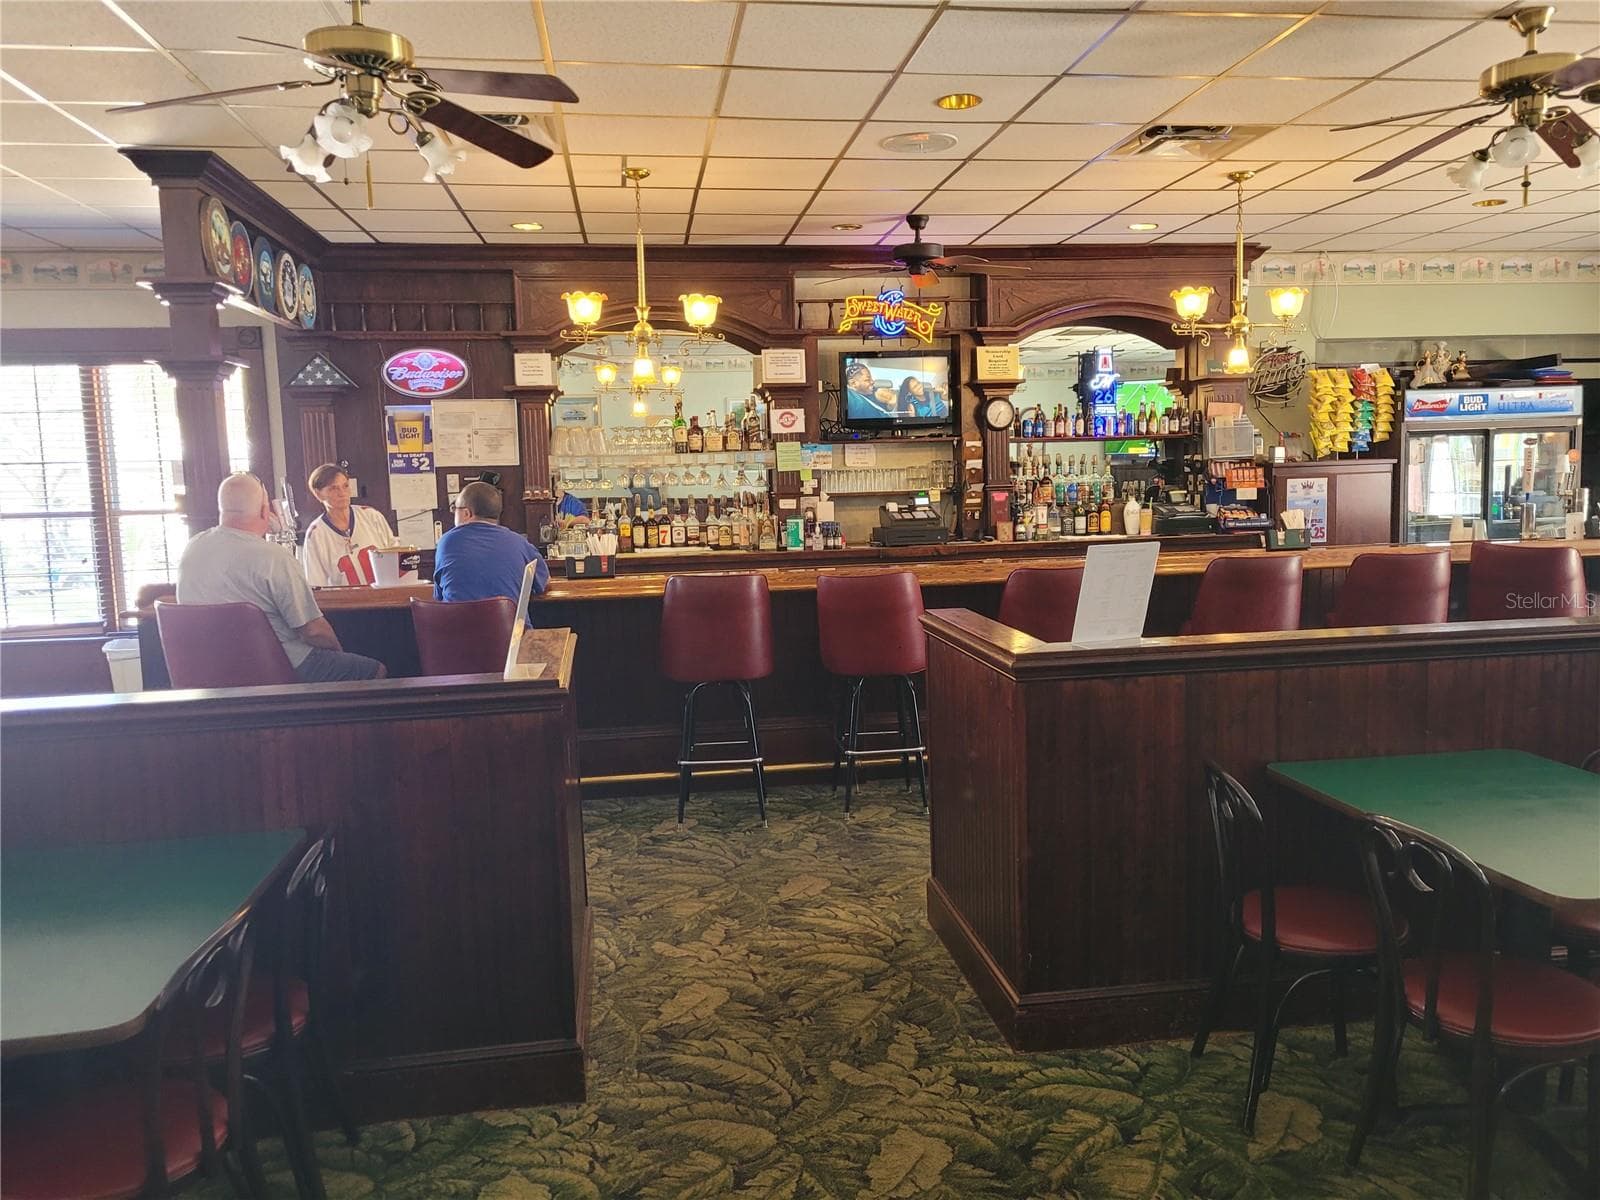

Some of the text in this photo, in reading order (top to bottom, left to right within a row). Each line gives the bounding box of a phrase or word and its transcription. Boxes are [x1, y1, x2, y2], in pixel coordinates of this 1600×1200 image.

[388, 366, 463, 380] Budweiser
[1463, 395, 1484, 404] BUD
[1459, 403, 1488, 412] LIGHT
[1498, 401, 1536, 411] ULTRA
[411, 457, 430, 470] $2
[660, 530, 668, 544] 7
